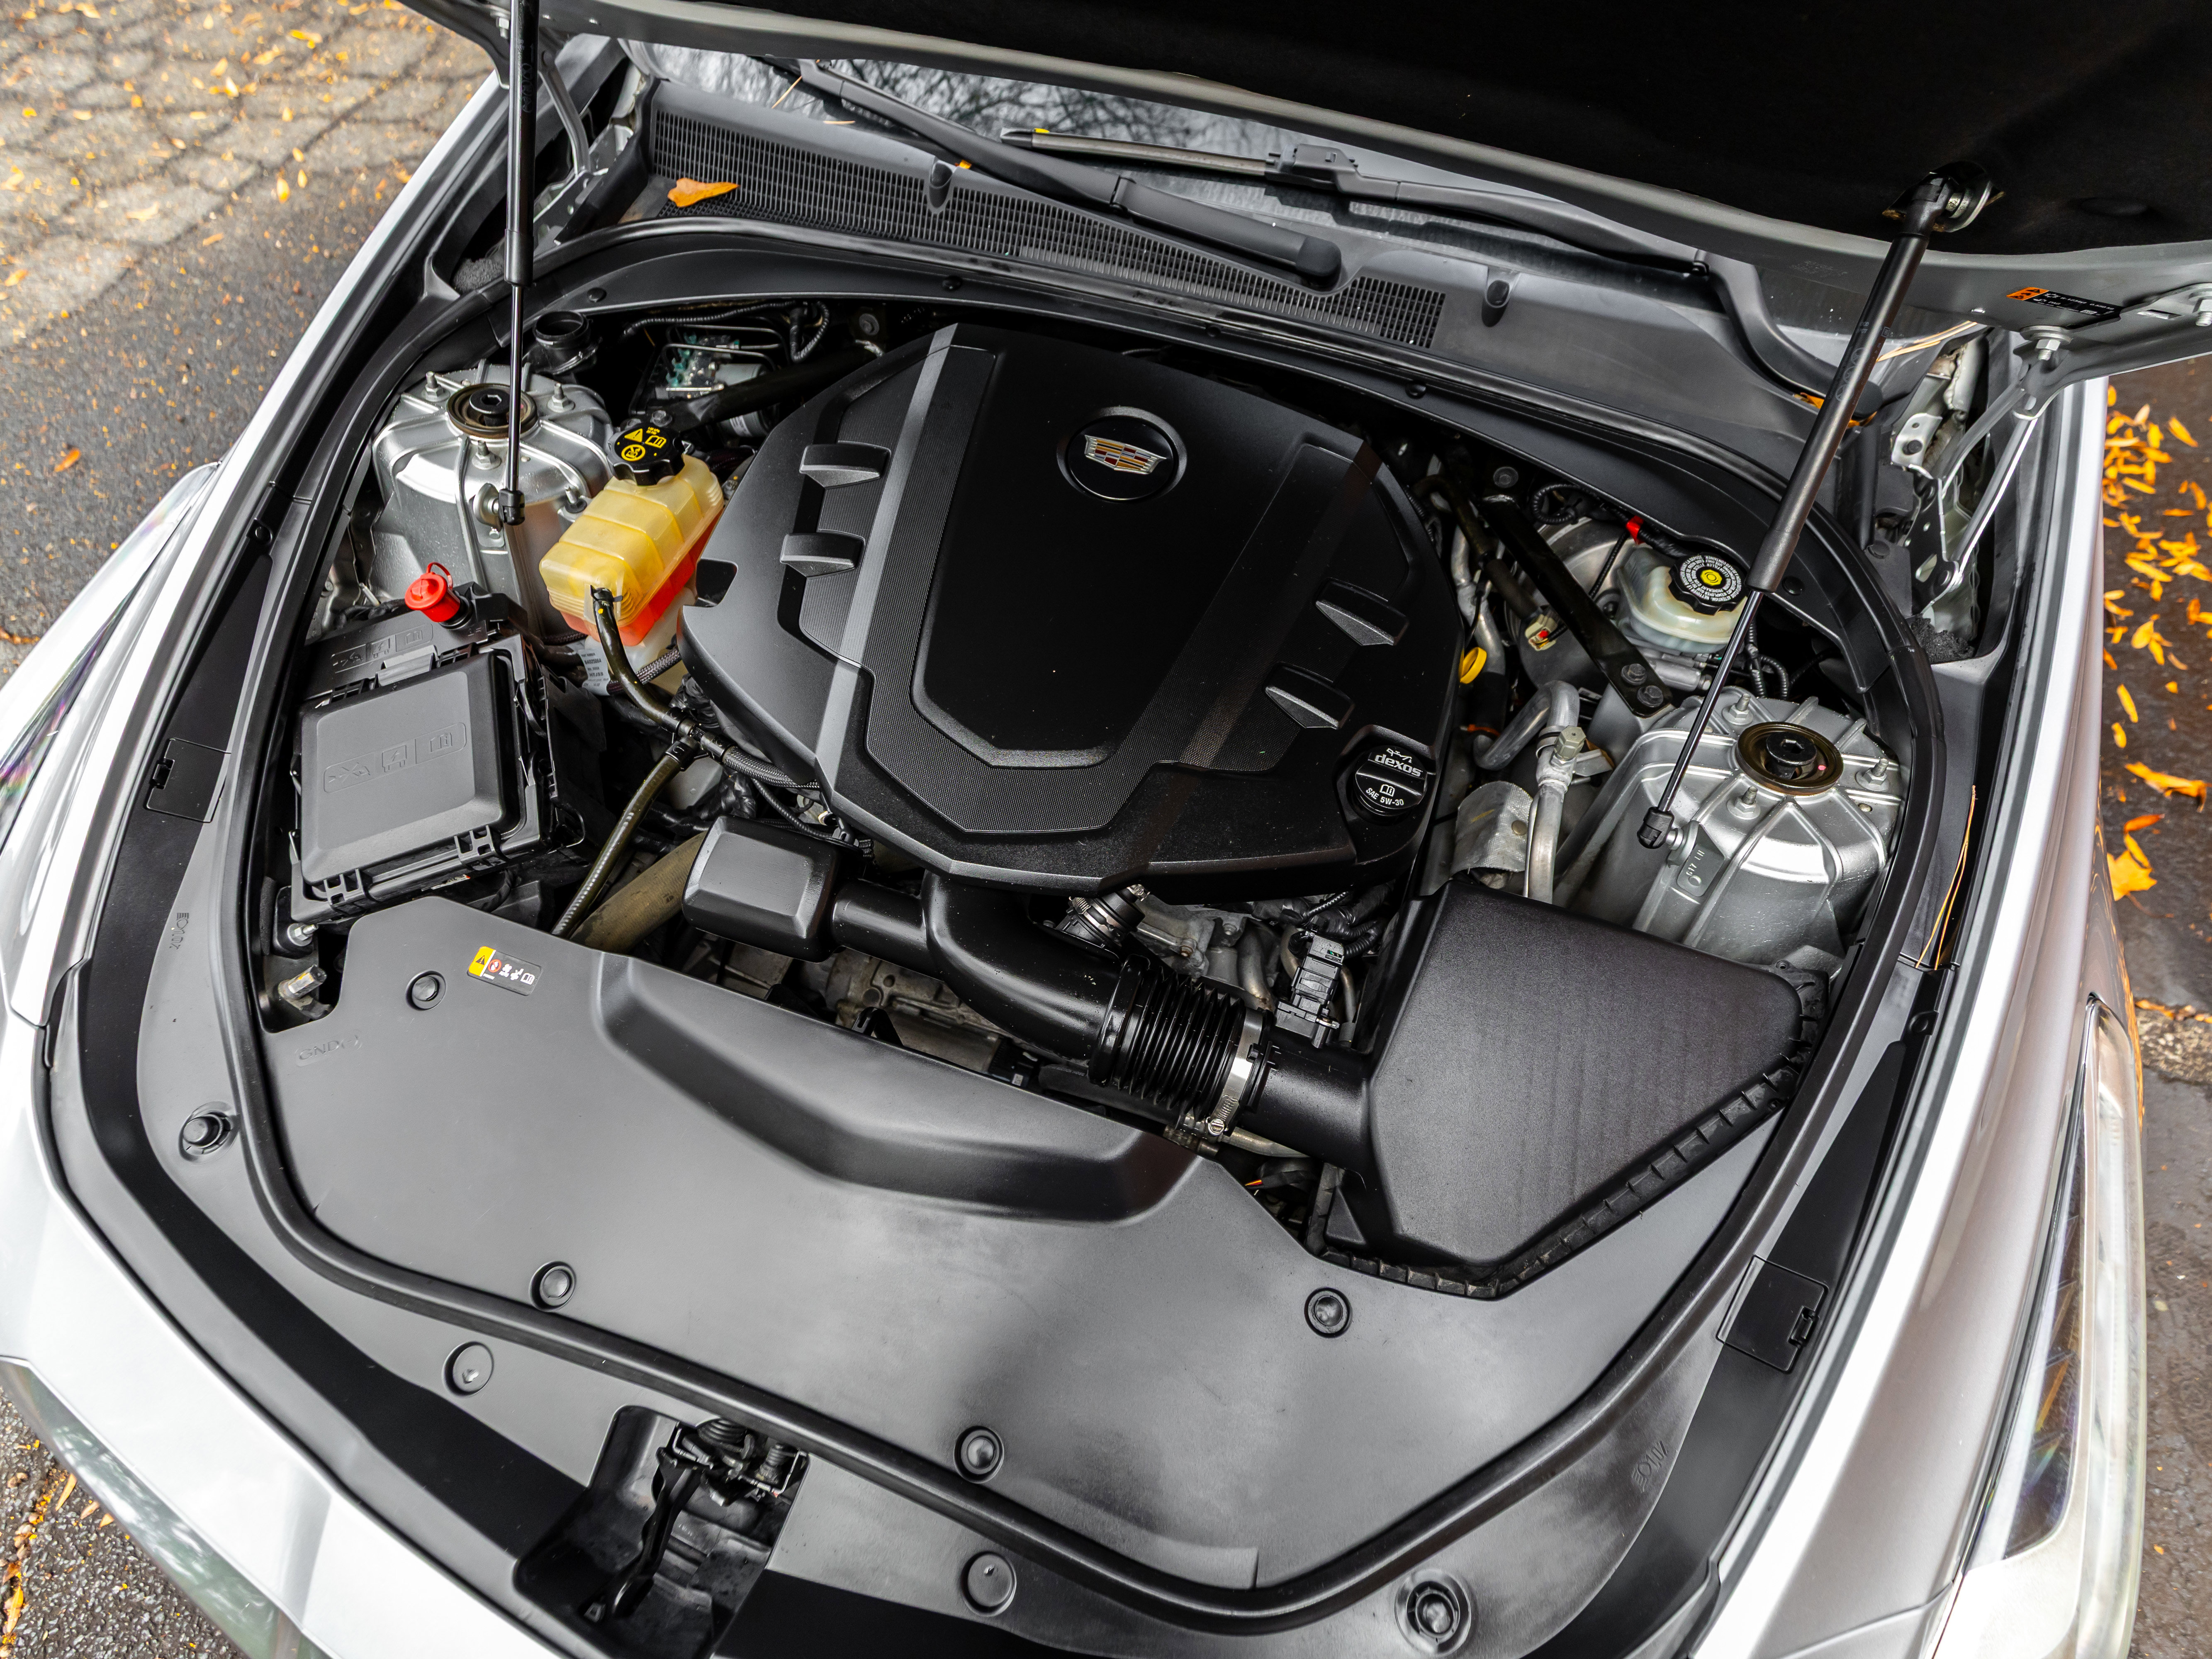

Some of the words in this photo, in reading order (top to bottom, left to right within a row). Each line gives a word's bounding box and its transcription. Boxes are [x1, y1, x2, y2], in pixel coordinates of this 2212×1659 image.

[1375, 754, 1421, 777] dexos
[1366, 788, 1380, 800] SAE
[1380, 796, 1404, 806] 5W-30
